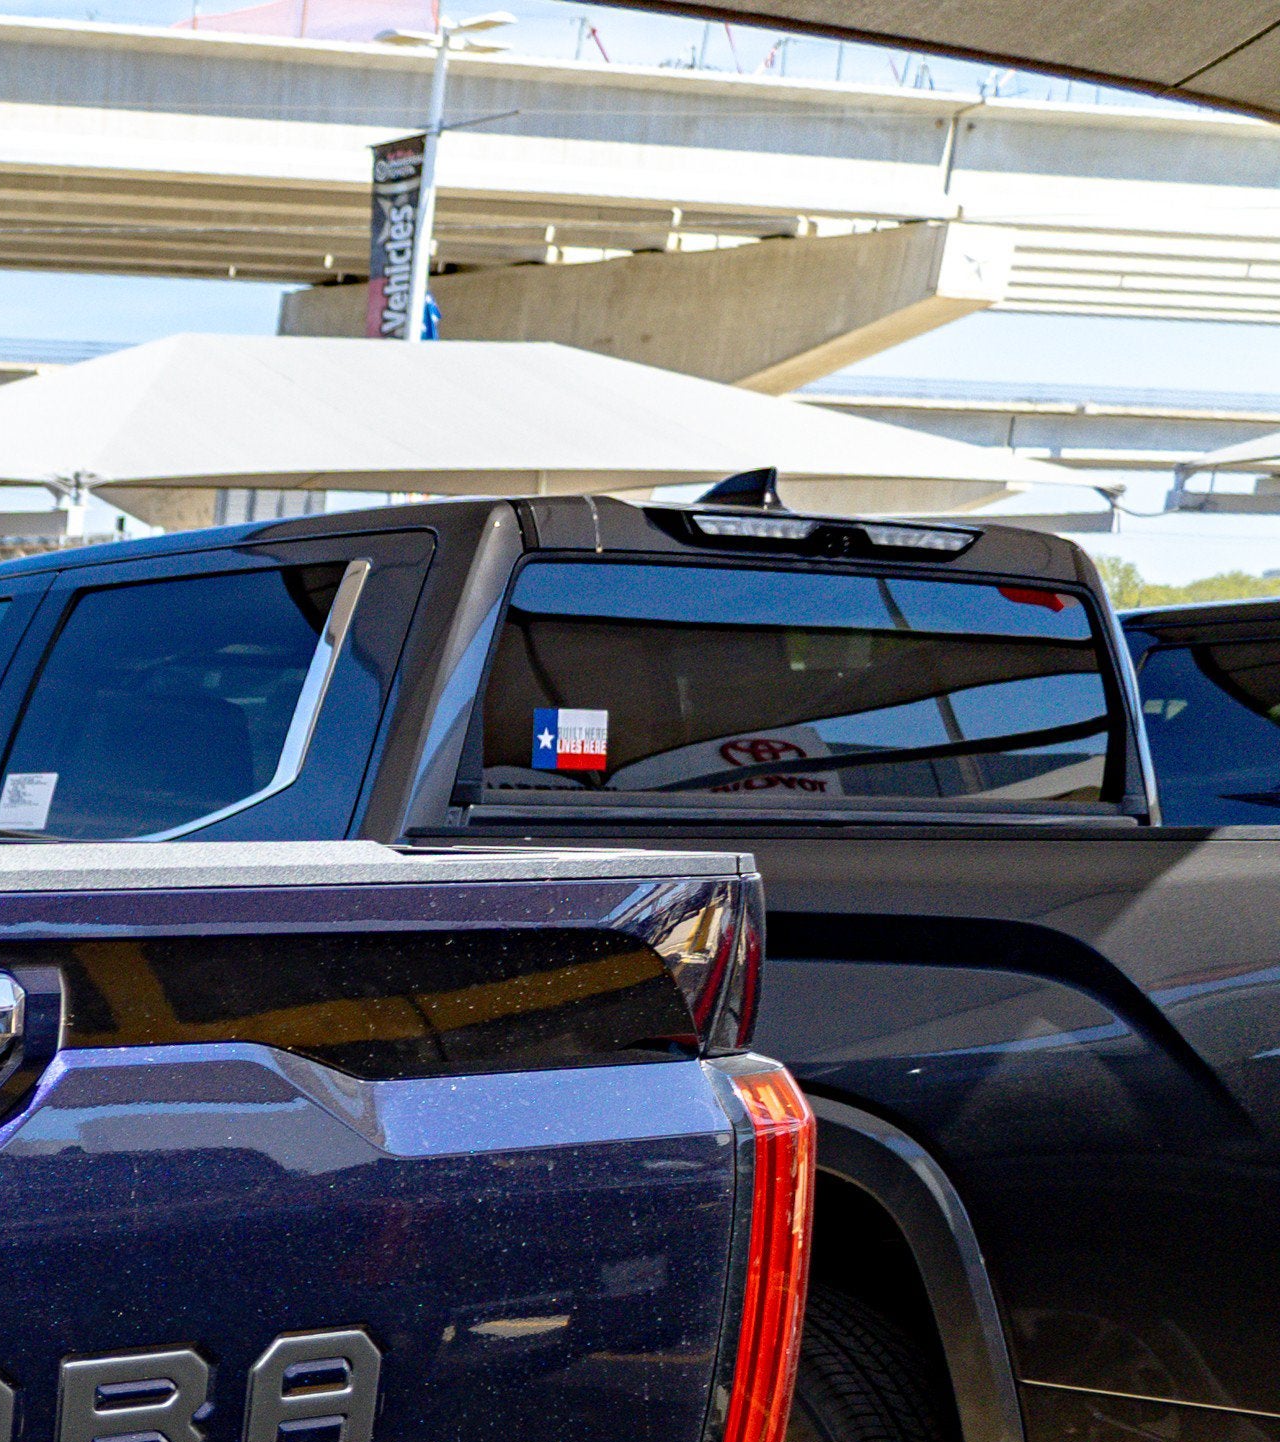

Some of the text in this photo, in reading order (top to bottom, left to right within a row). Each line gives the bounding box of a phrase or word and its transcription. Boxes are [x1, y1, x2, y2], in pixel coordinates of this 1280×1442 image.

[381, 203, 415, 335] Vehicles
[557, 739, 607, 755] LIVES HERE
